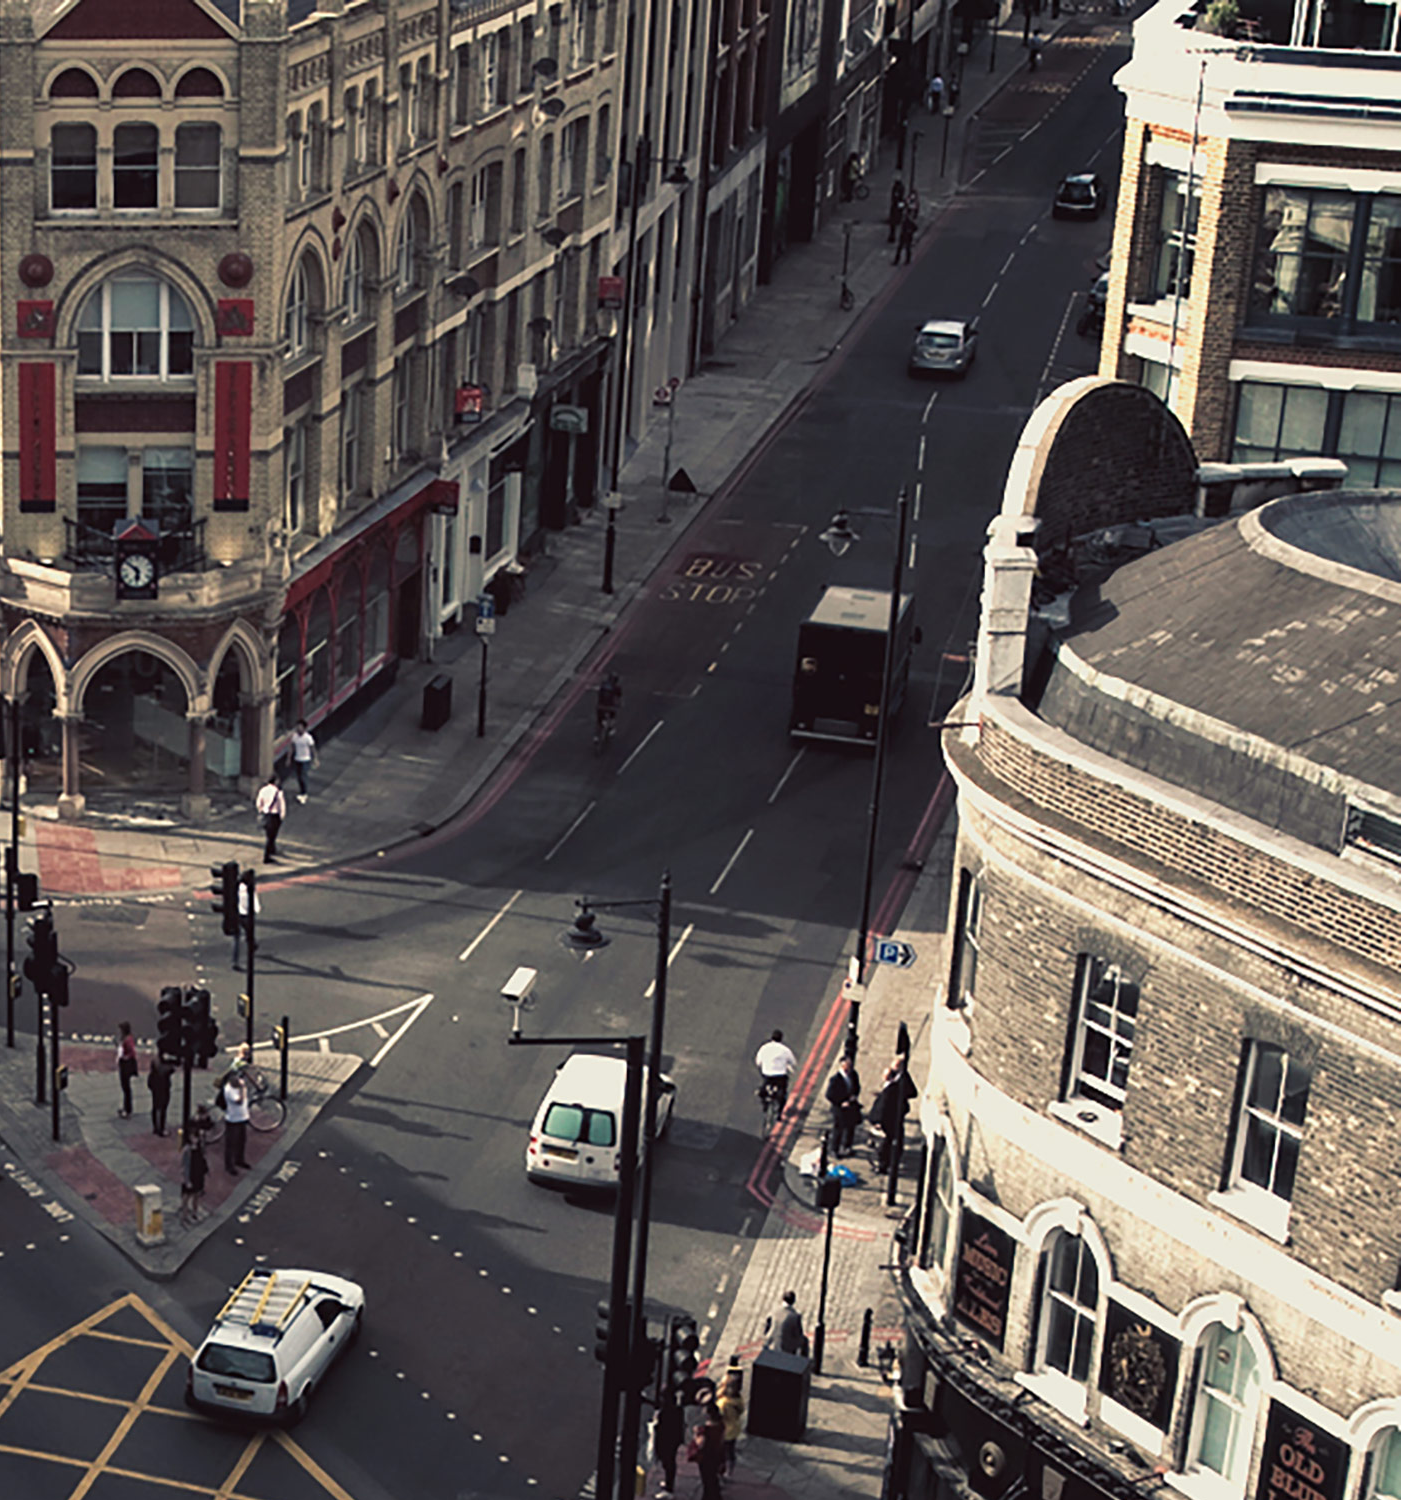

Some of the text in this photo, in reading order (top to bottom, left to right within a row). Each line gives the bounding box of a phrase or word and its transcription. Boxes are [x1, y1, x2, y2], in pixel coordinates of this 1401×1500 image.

[685, 559, 762, 579] BUS
[659, 582, 756, 604] STOP
[962, 1242, 1008, 1287] MUSIC
[956, 1296, 1002, 1337] ALES
[1279, 1443, 1325, 1485] OLD
